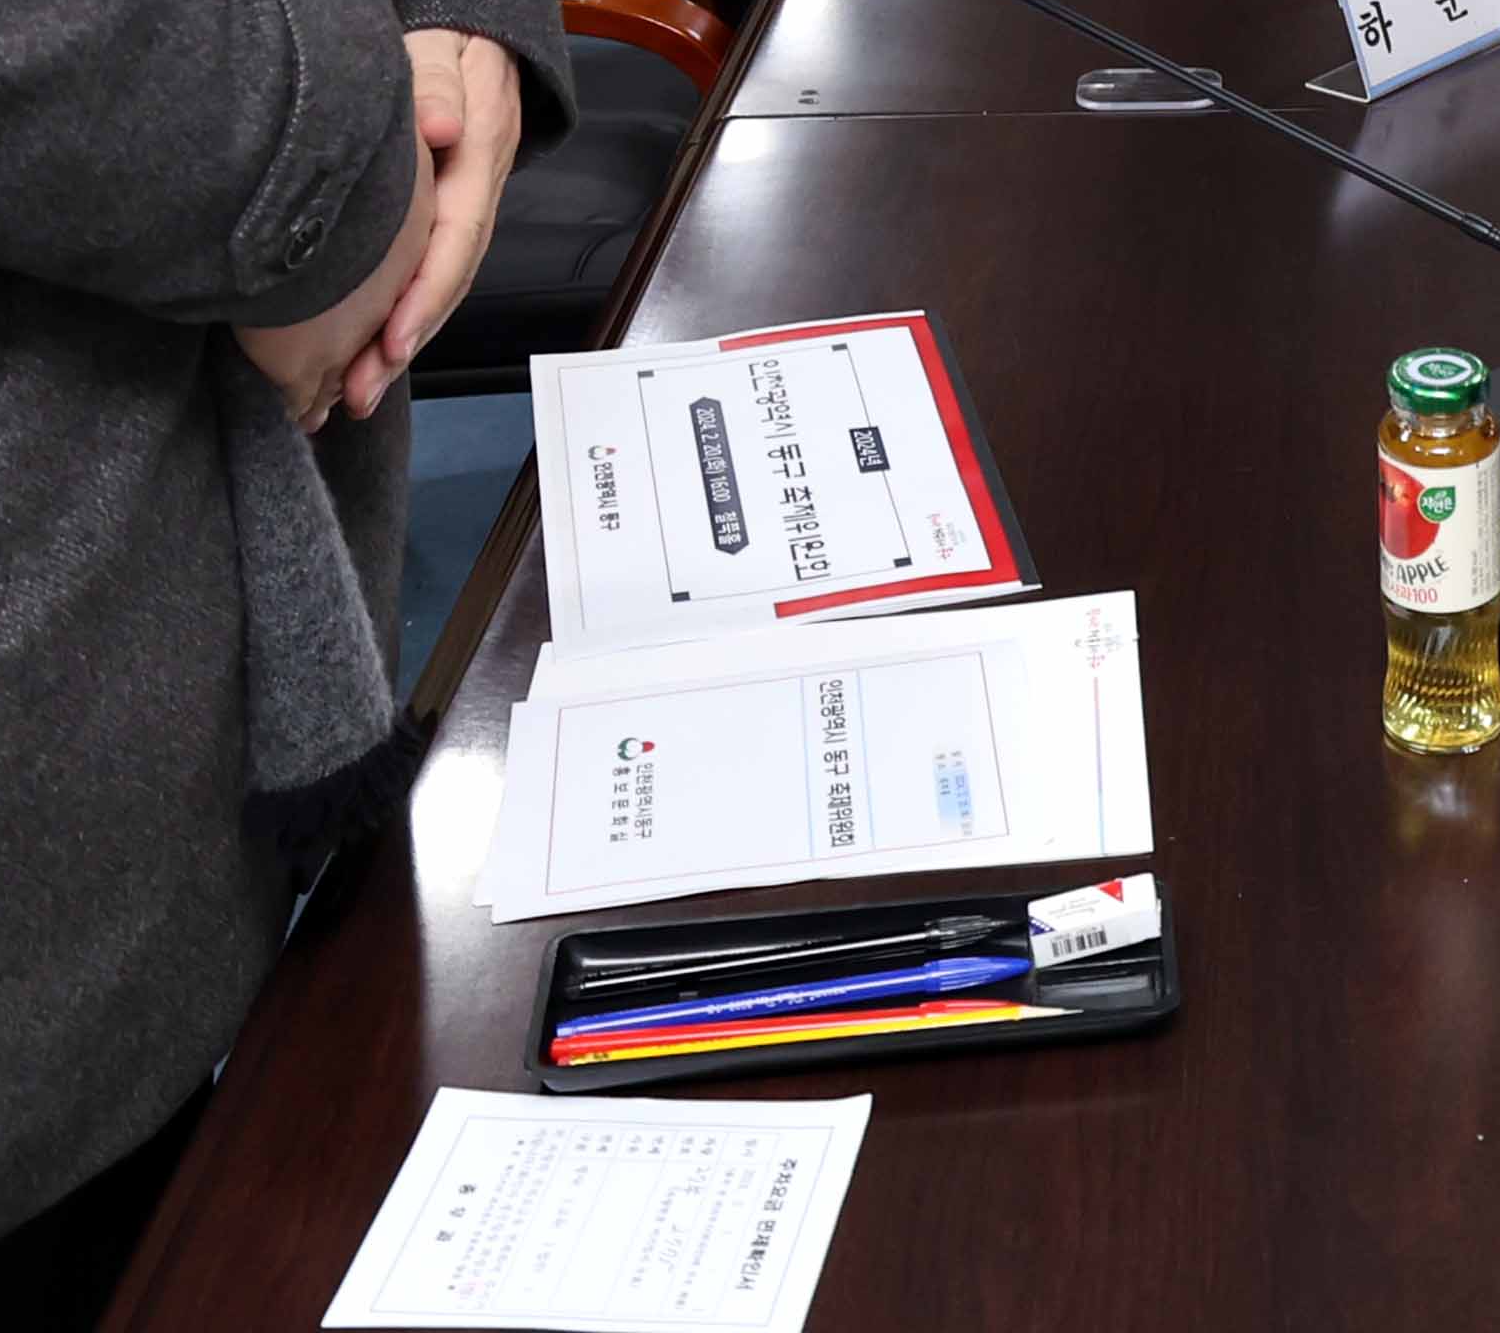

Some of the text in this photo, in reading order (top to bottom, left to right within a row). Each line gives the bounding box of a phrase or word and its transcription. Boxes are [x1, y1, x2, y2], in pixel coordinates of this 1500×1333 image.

[749, 359, 832, 581] 인천광역시 동구 축제위원회
[853, 429, 884, 467] 2024년
[593, 463, 621, 532] 인천광역시 동구
[712, 475, 732, 503] 16:00
[1396, 555, 1449, 585] APPLE
[820, 679, 856, 848] 인천광역시 동구 축제위원회
[763, 1158, 798, 1212] 주차요금
